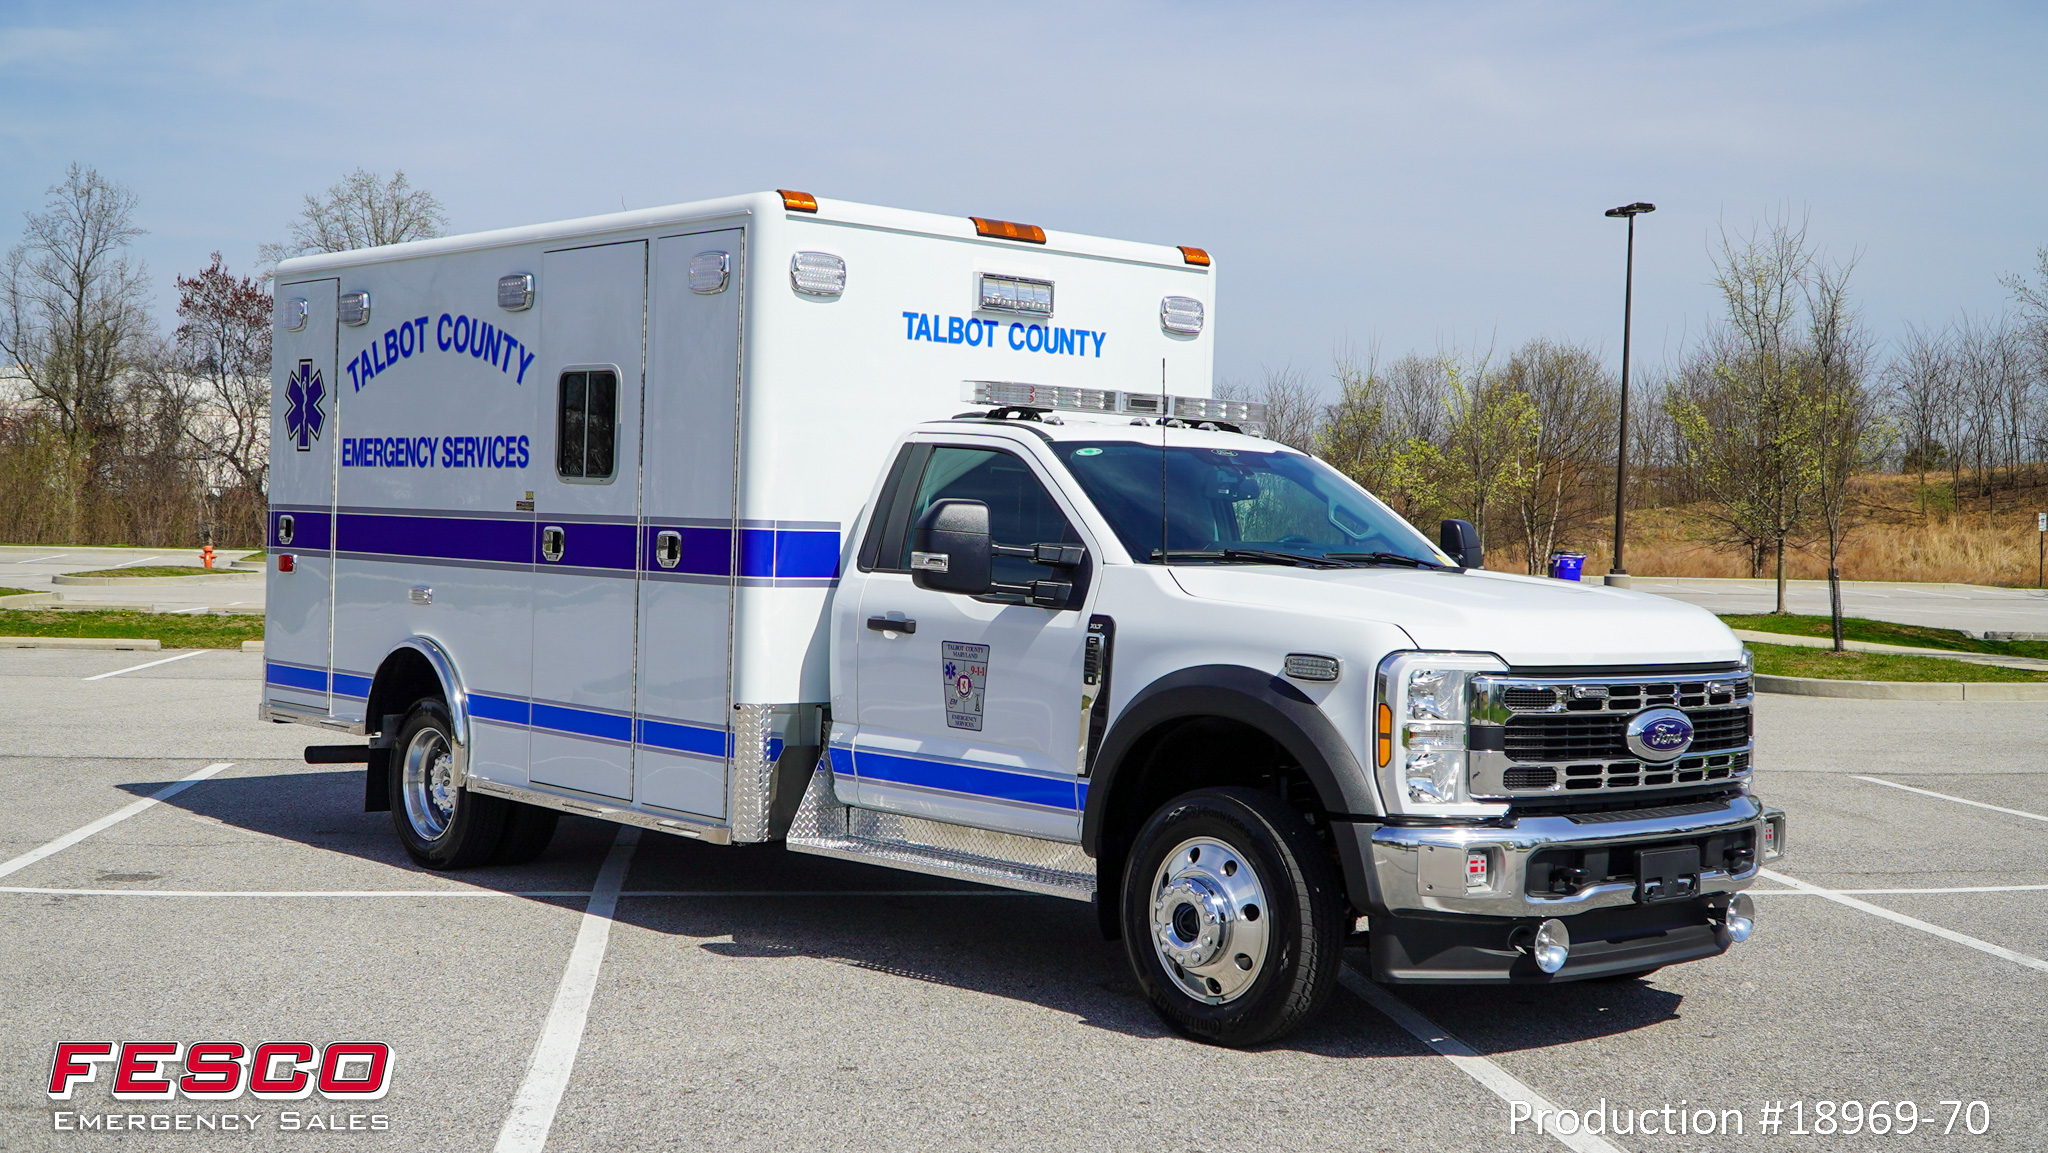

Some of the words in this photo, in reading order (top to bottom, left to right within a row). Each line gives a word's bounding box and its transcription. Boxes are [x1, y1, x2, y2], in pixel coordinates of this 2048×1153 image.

[903, 311, 999, 347] TALBOT
[1008, 322, 1107, 358] COUNTY
[346, 316, 429, 393] TALBOT
[437, 313, 536, 386] COUNTY
[342, 437, 439, 468] EMERGENCY
[442, 435, 530, 469] SERVICES
[952, 651, 979, 659] MARYLAND
[970, 665, 985, 677] 9-1-1
[951, 714, 977, 722] EMERGENCY
[1652, 723, 1683, 746] Ford
